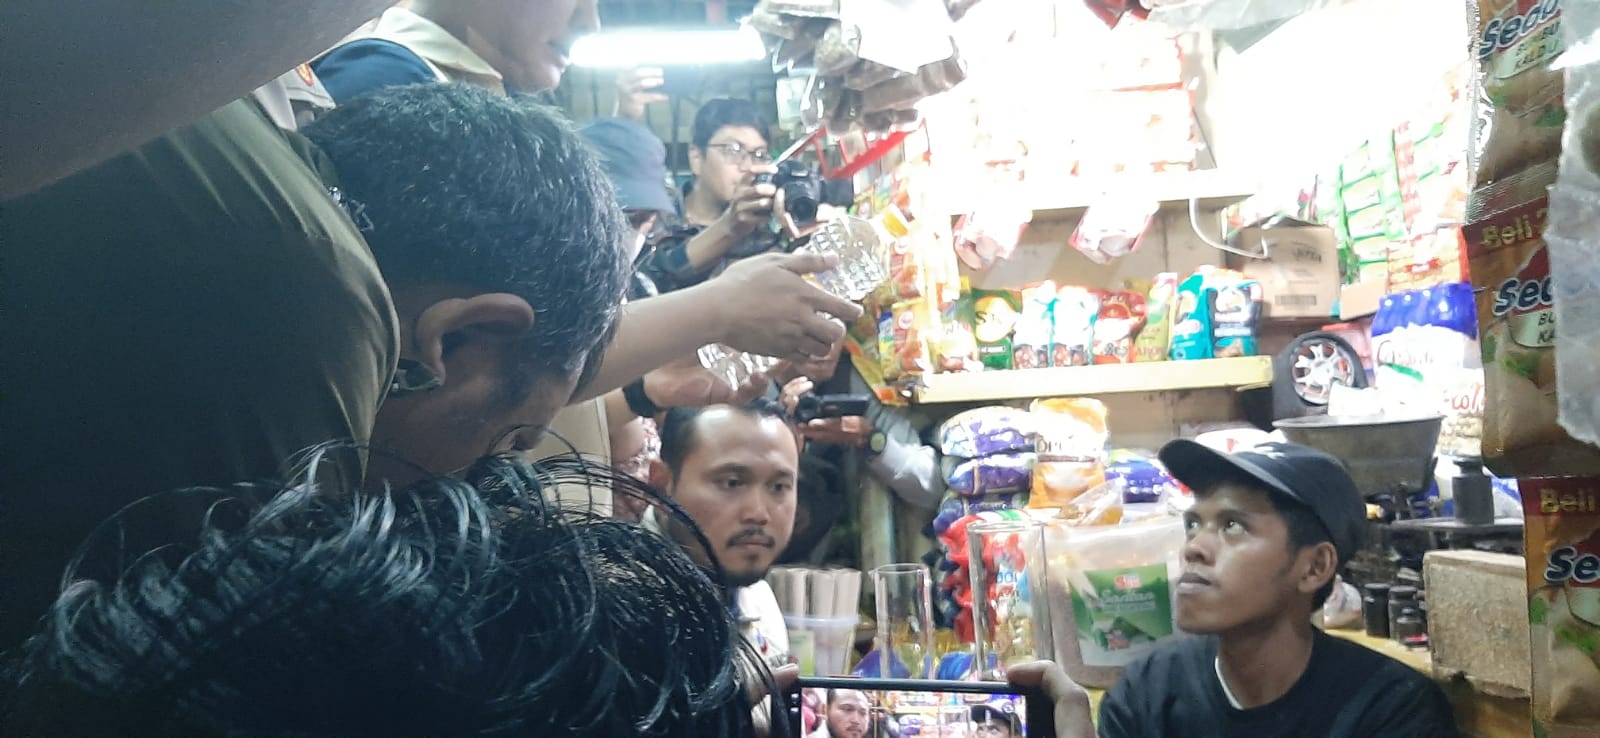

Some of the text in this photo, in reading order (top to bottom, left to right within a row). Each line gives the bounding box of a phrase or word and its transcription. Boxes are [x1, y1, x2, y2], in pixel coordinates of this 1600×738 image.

[1481, 214, 1533, 246] Beli
[1540, 488, 1596, 512] Beli
[1544, 546, 1600, 582] Se
